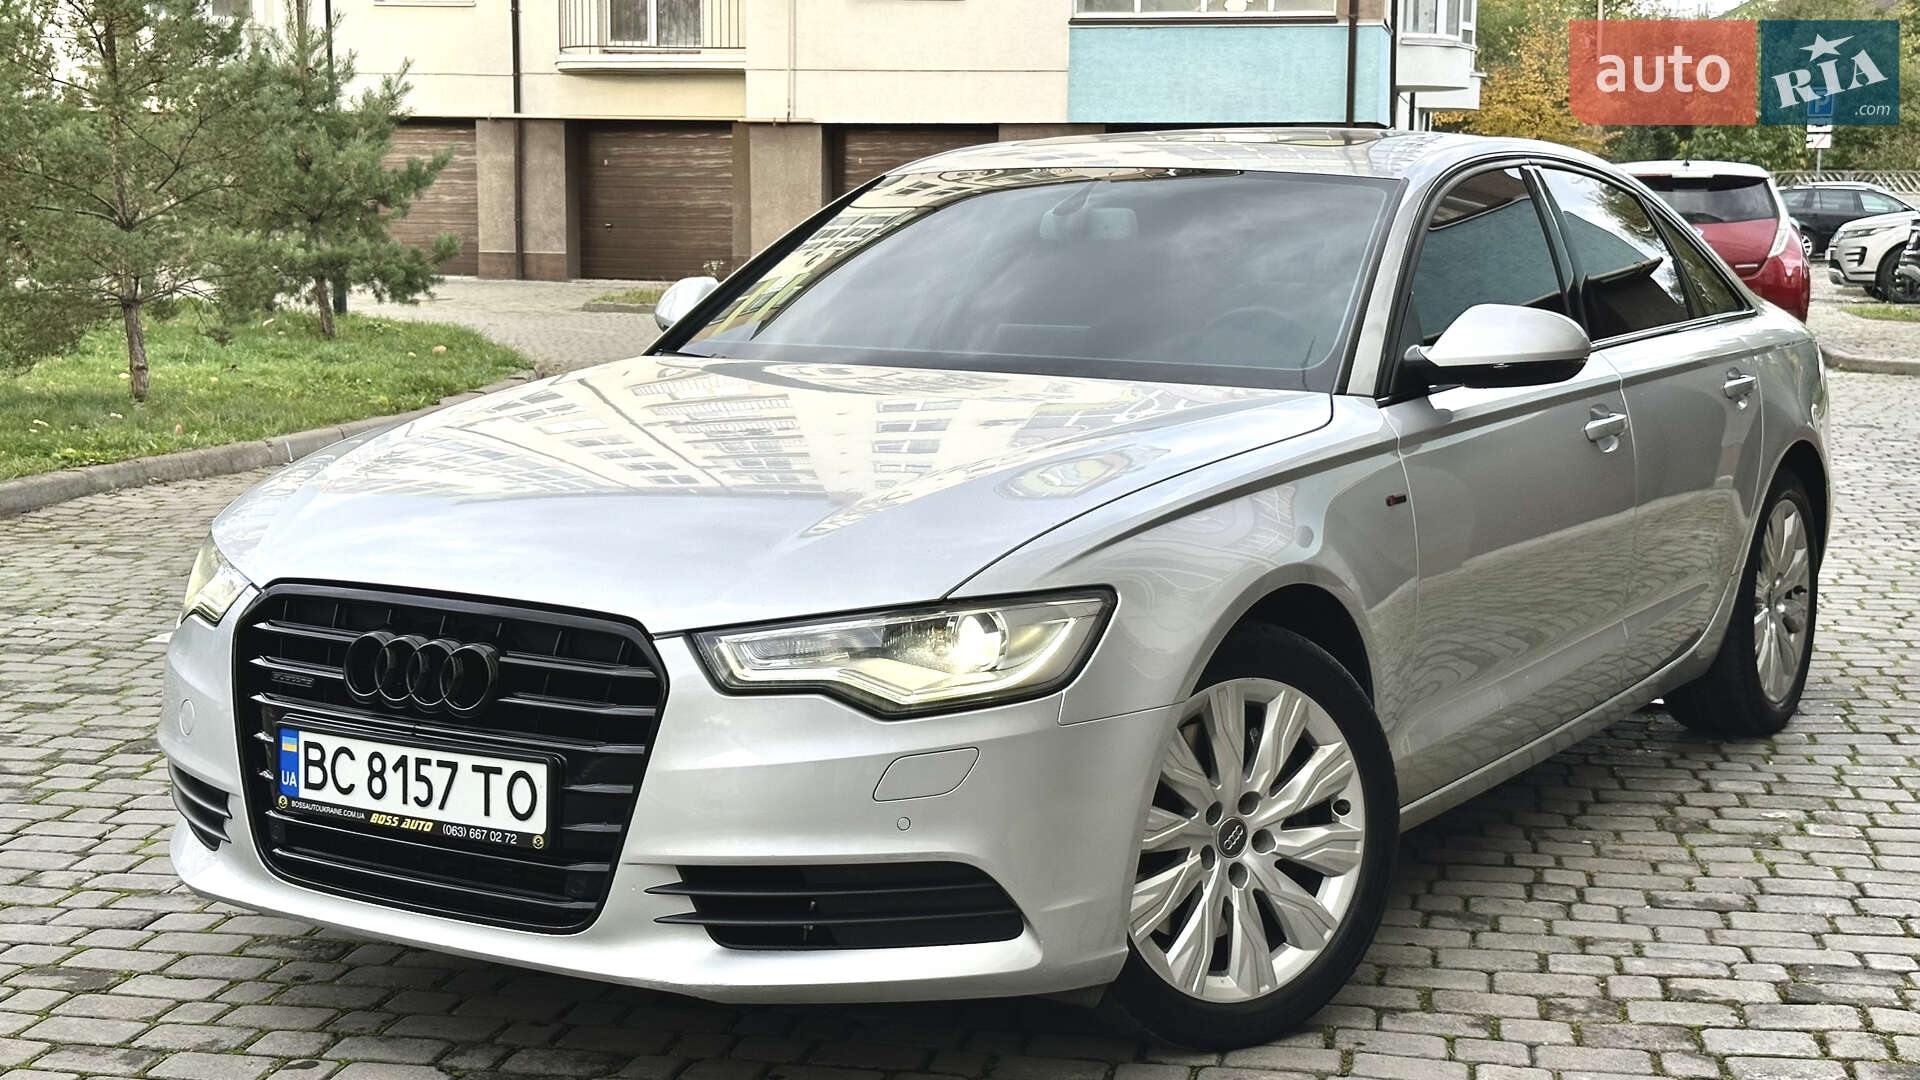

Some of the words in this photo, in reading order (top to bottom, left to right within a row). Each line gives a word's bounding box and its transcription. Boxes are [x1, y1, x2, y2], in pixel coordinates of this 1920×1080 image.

[281, 770, 298, 787] UA
[303, 740, 356, 796] BC
[367, 751, 459, 812] 8157
[471, 764, 538, 822] TO
[369, 812, 400, 828] BOSS
[400, 818, 434, 832] AUTO
[442, 823, 467, 838] (063)
[468, 828, 488, 840] 667
[489, 830, 503, 843] 02
[504, 833, 518, 845] 72
